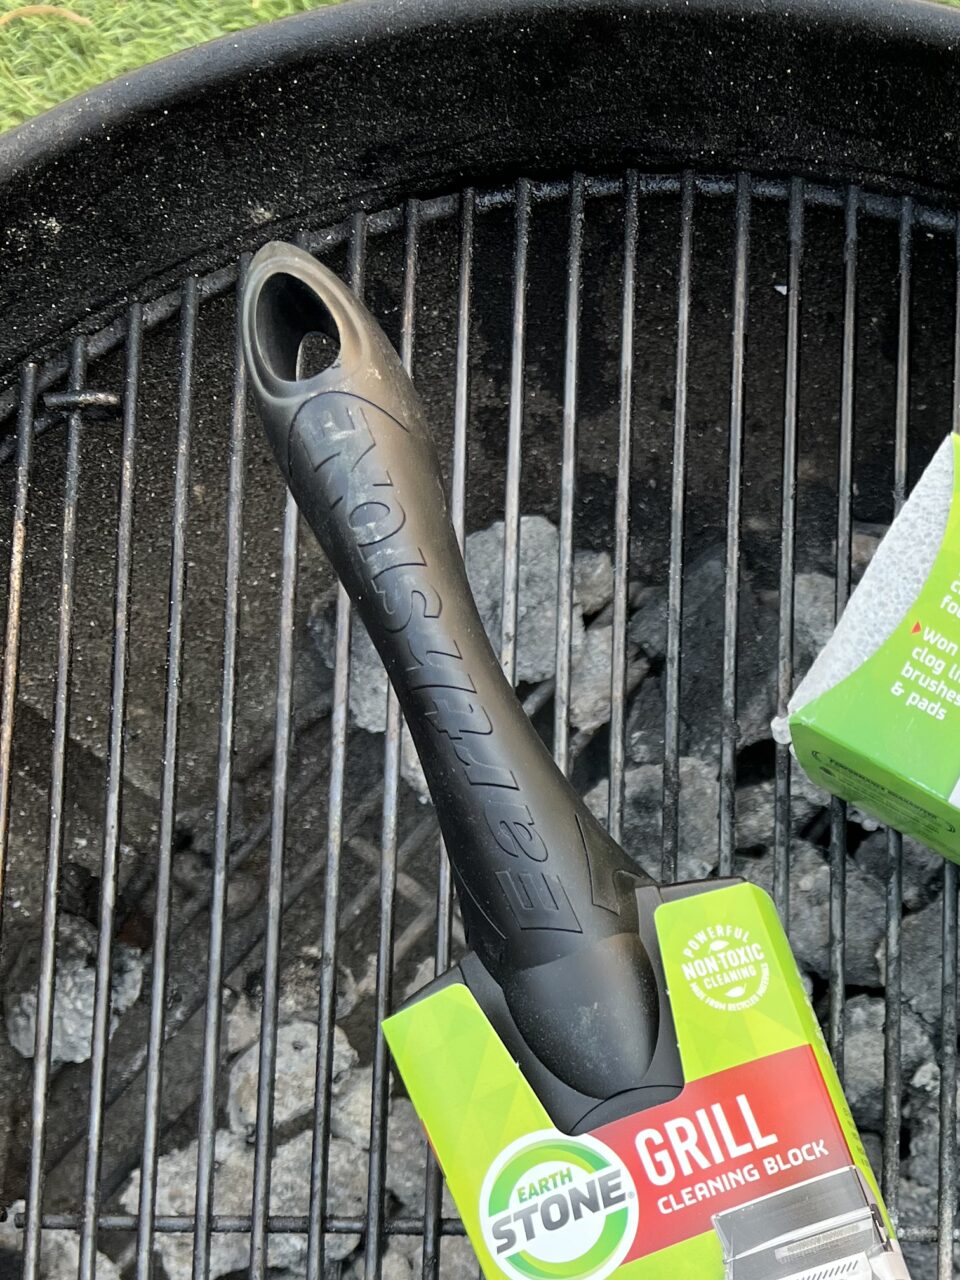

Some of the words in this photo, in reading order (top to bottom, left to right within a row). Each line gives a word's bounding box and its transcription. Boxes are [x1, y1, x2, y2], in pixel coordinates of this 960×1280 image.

[911, 646, 946, 676] clog
[890, 681, 904, 696] &
[905, 692, 947, 721] pads
[683, 924, 749, 958] POWERFUL
[681, 943, 765, 980] NON-TOXIC
[703, 965, 757, 990] CLEANING
[634, 1093, 778, 1187] GRILL
[517, 1168, 573, 1203] EARTH
[657, 1164, 760, 1215] CLEANING
[763, 1139, 829, 1176] BLOCK
[491, 1169, 626, 1255] STONE
